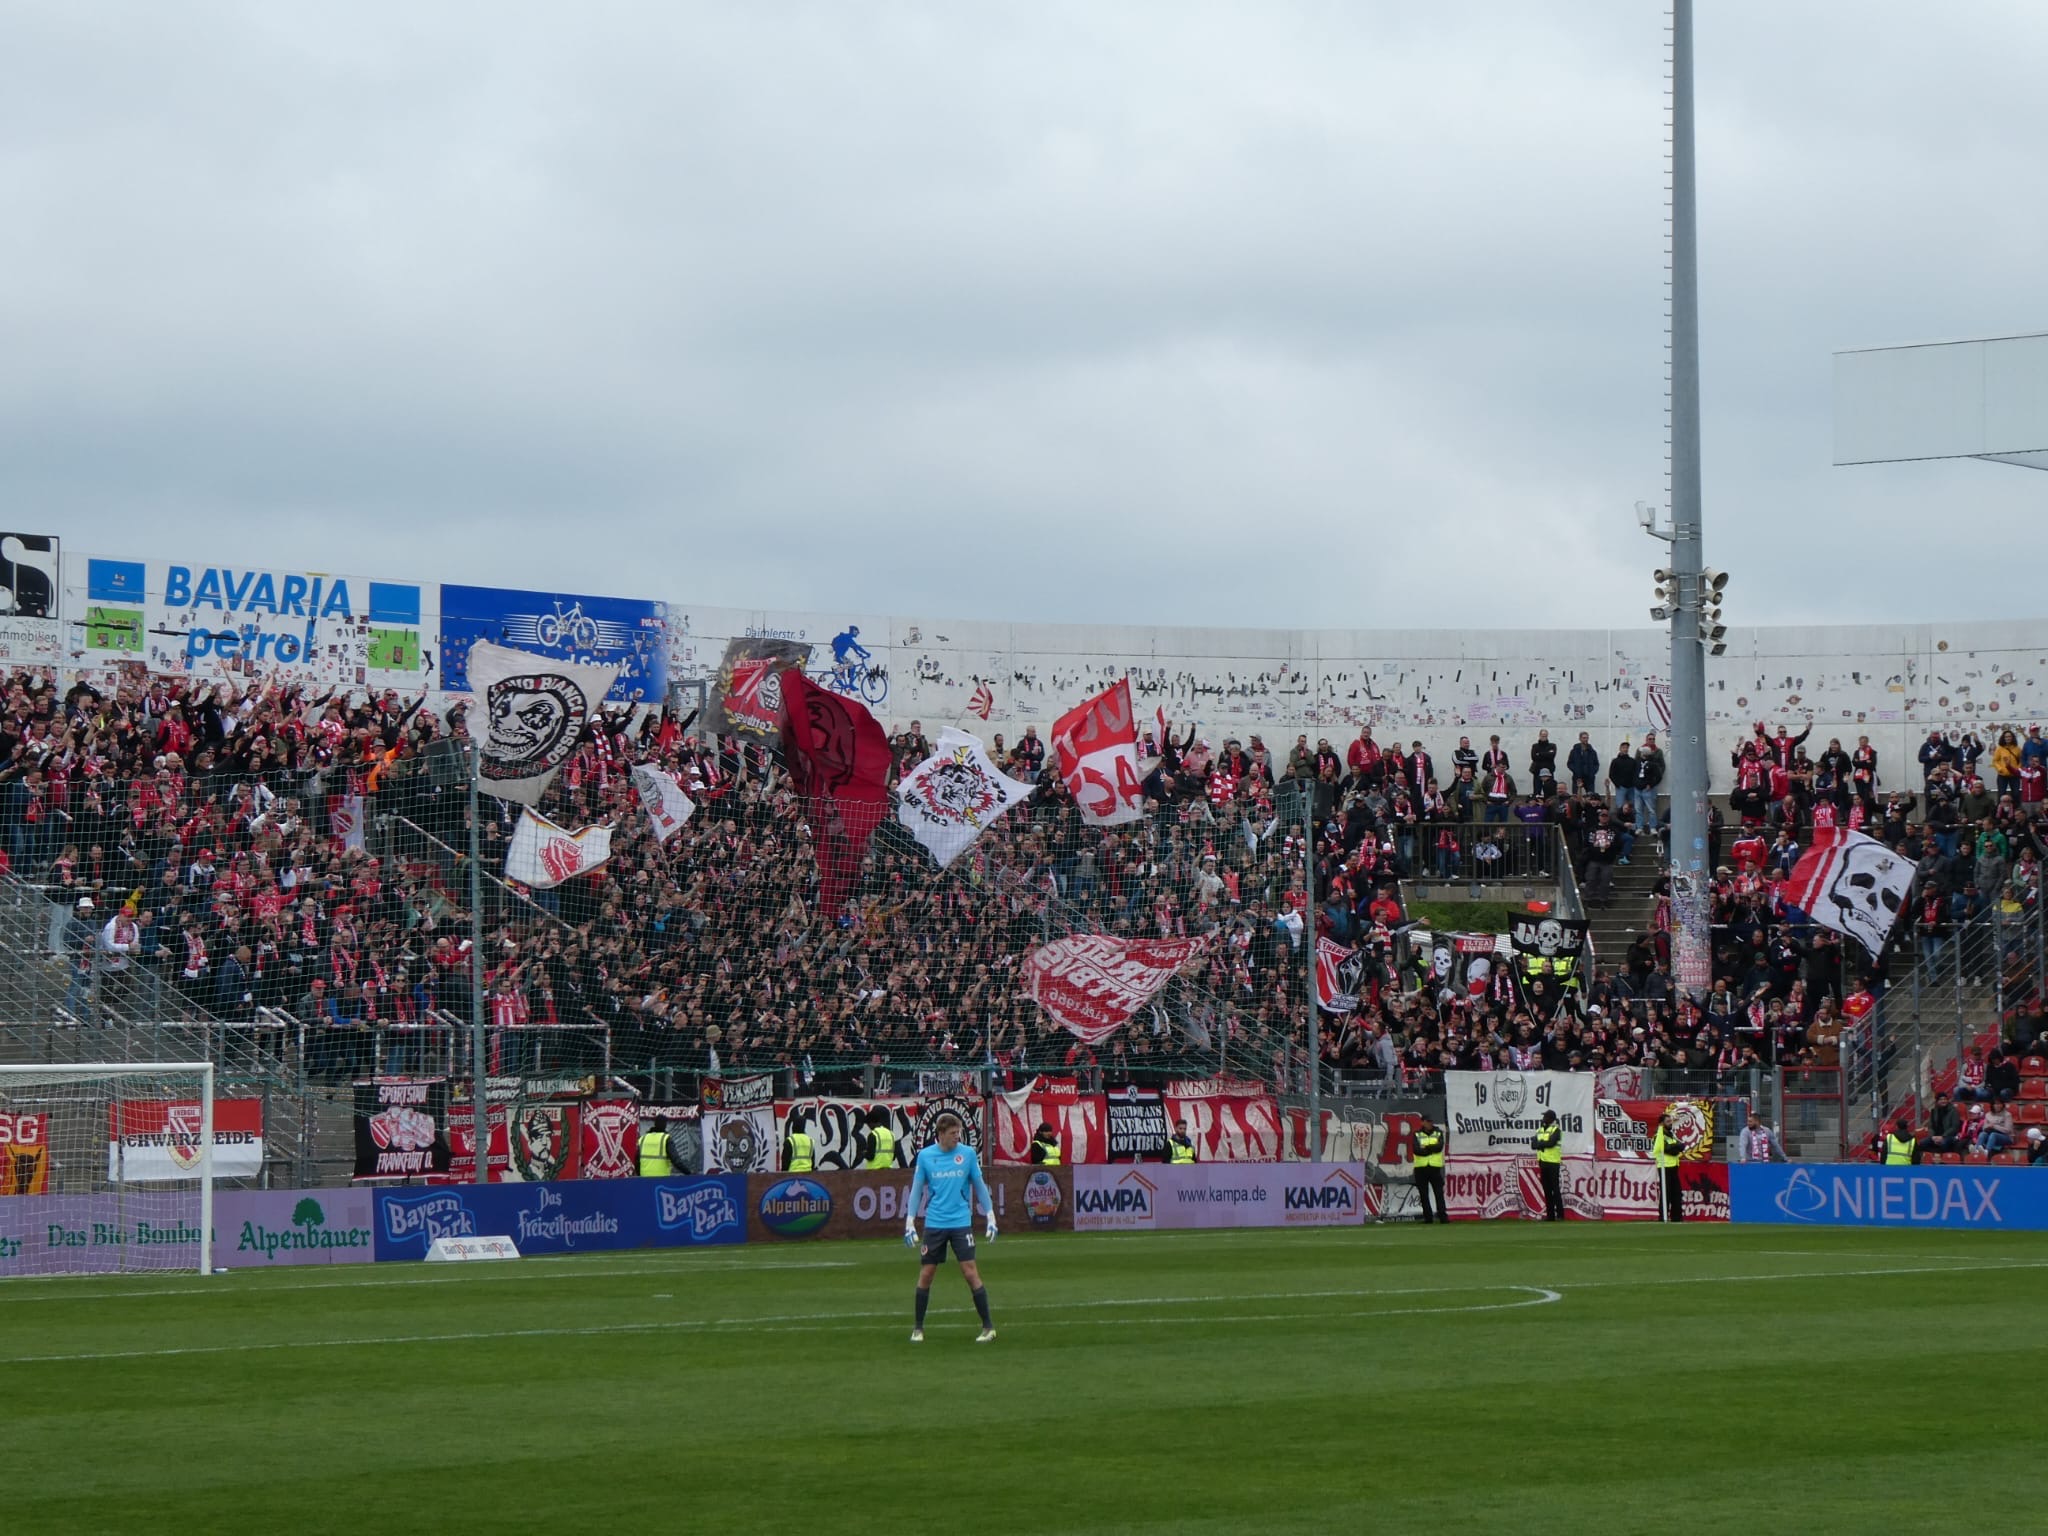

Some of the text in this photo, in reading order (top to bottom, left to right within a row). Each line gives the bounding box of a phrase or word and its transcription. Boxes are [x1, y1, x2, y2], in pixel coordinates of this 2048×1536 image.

[164, 566, 352, 618] BAVARIA
[185, 622, 315, 669] petrol
[1050, 1085, 1076, 1094] FRONT
[1475, 1081, 1487, 1106] 19
[1598, 1105, 1621, 1117] RED
[1110, 1118, 1165, 1134] ENERGIE
[1602, 1121, 1647, 1134] EAGLES
[119, 1132, 254, 1148] SCHWARZEIDE
[1111, 1135, 1165, 1151] COTTBUS
[1606, 1138, 1653, 1150] COTTBU
[536, 1187, 562, 1213] Das
[660, 1187, 723, 1222] Bayern
[761, 1197, 830, 1215] Alpenhain
[1076, 1189, 1147, 1213] KAMPA
[1177, 1185, 1267, 1205] www.kampa.de
[1285, 1186, 1352, 1209] KAMPA
[1833, 1177, 2002, 1221] NIEDAX
[387, 1198, 460, 1235] Bayern
[517, 1210, 619, 1247] Freizeitparadies
[694, 1202, 735, 1233] Park
[48, 1224, 88, 1248] Das
[238, 1221, 371, 1260] Alpenbauer
[427, 1212, 473, 1246] Park
